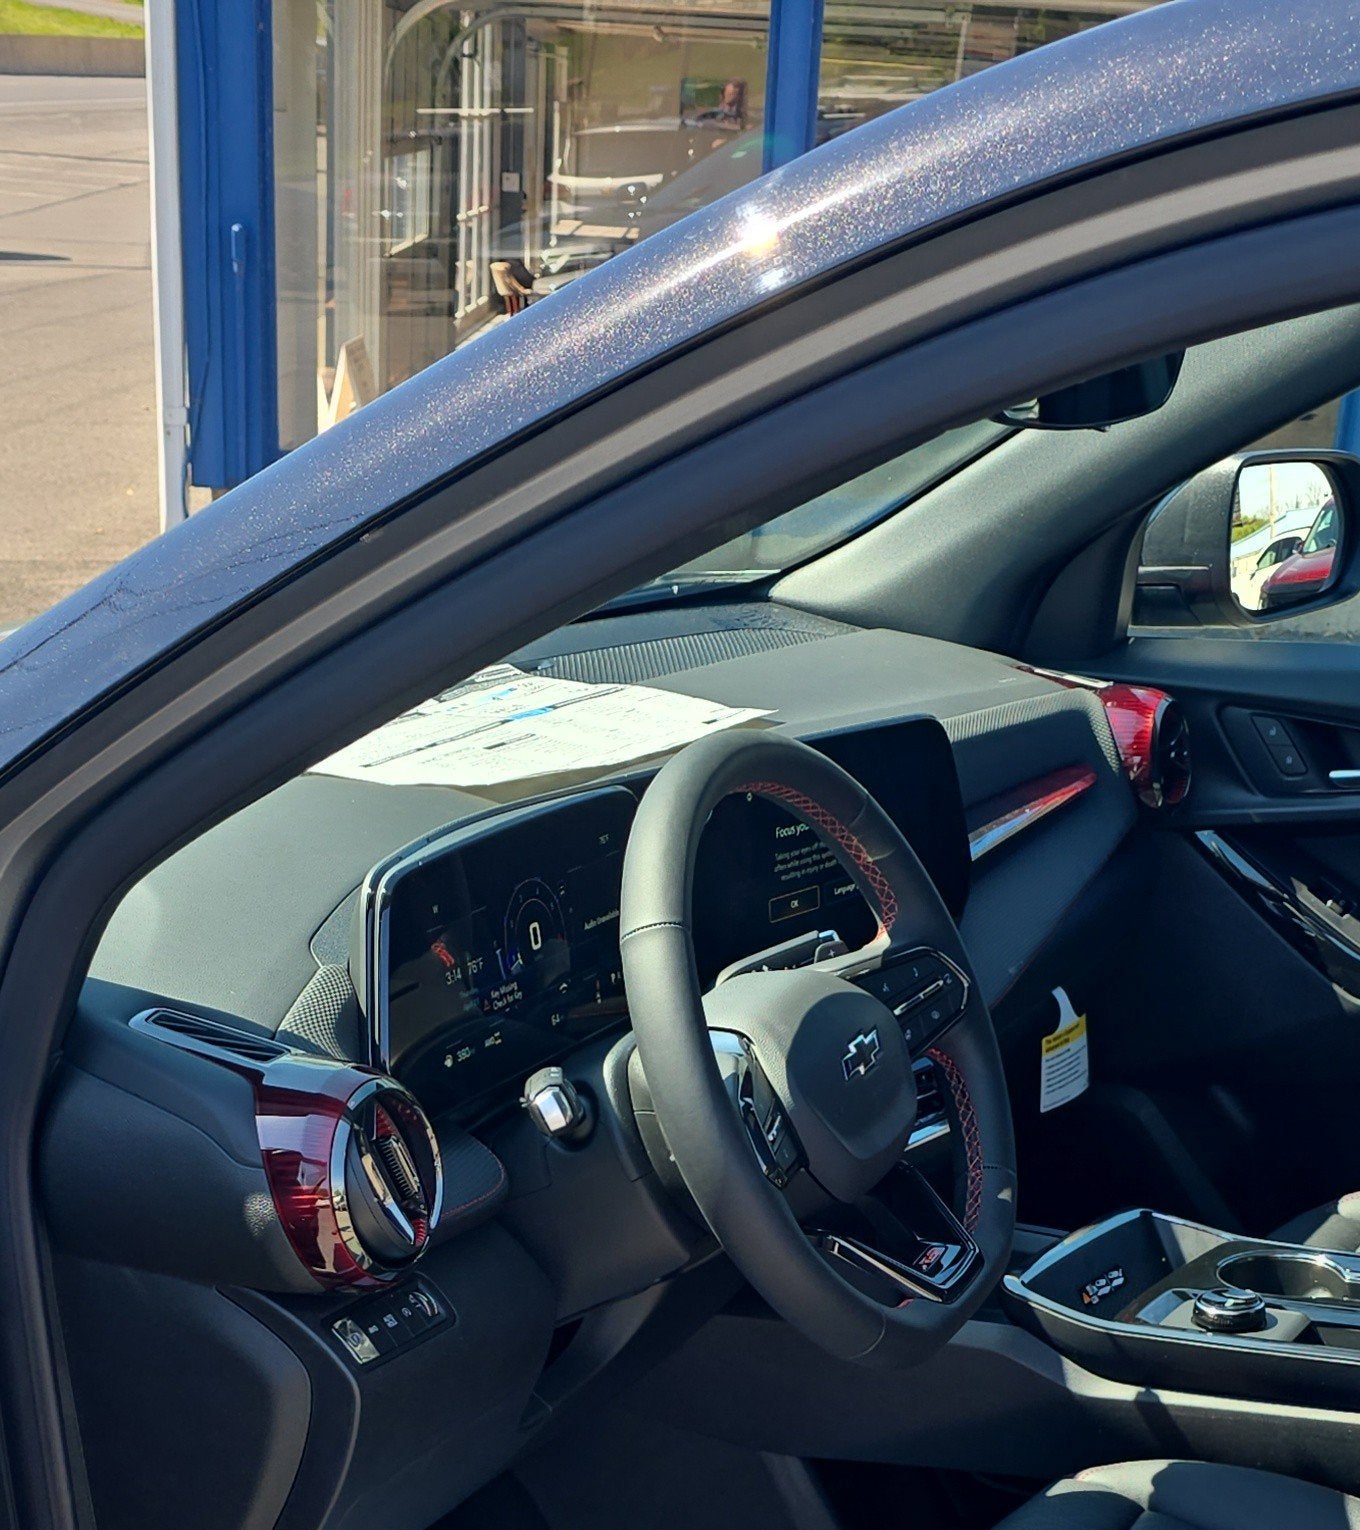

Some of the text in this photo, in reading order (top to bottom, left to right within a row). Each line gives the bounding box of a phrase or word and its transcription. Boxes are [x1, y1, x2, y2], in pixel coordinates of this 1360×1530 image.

[775, 826, 796, 839] Focus
[529, 921, 542, 951] 0
[445, 967, 462, 986] 3:14
